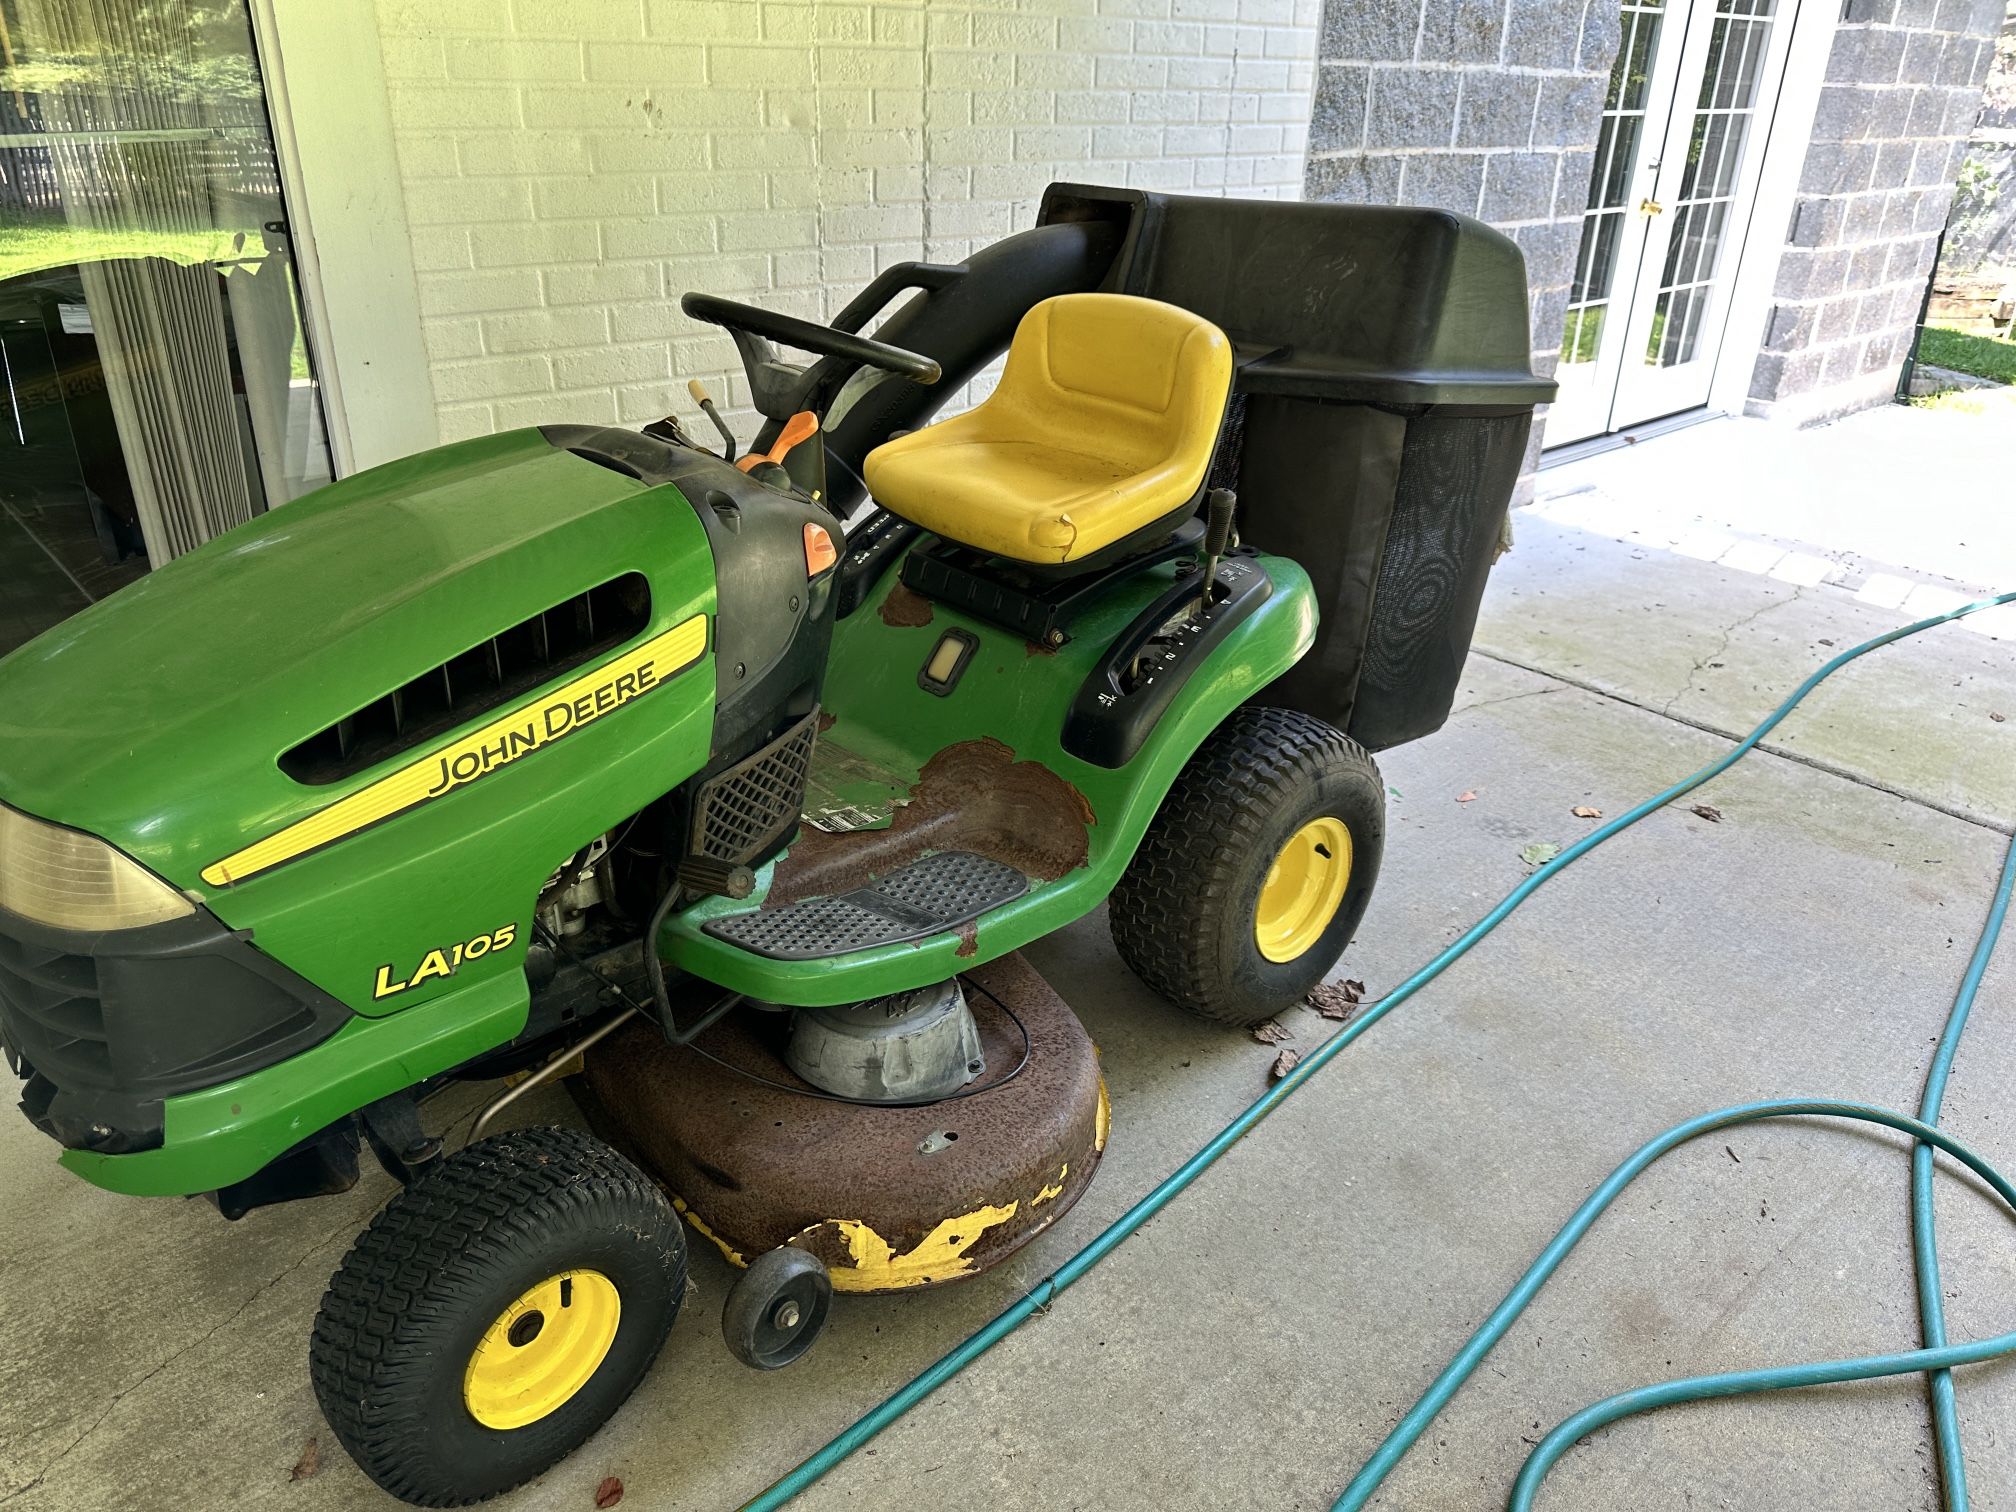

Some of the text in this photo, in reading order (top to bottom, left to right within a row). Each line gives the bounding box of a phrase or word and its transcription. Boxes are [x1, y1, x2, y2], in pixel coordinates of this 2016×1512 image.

[1164, 652, 1176, 661] 2
[428, 660, 658, 795] JOHN DEERE
[372, 922, 519, 1001] LA105
